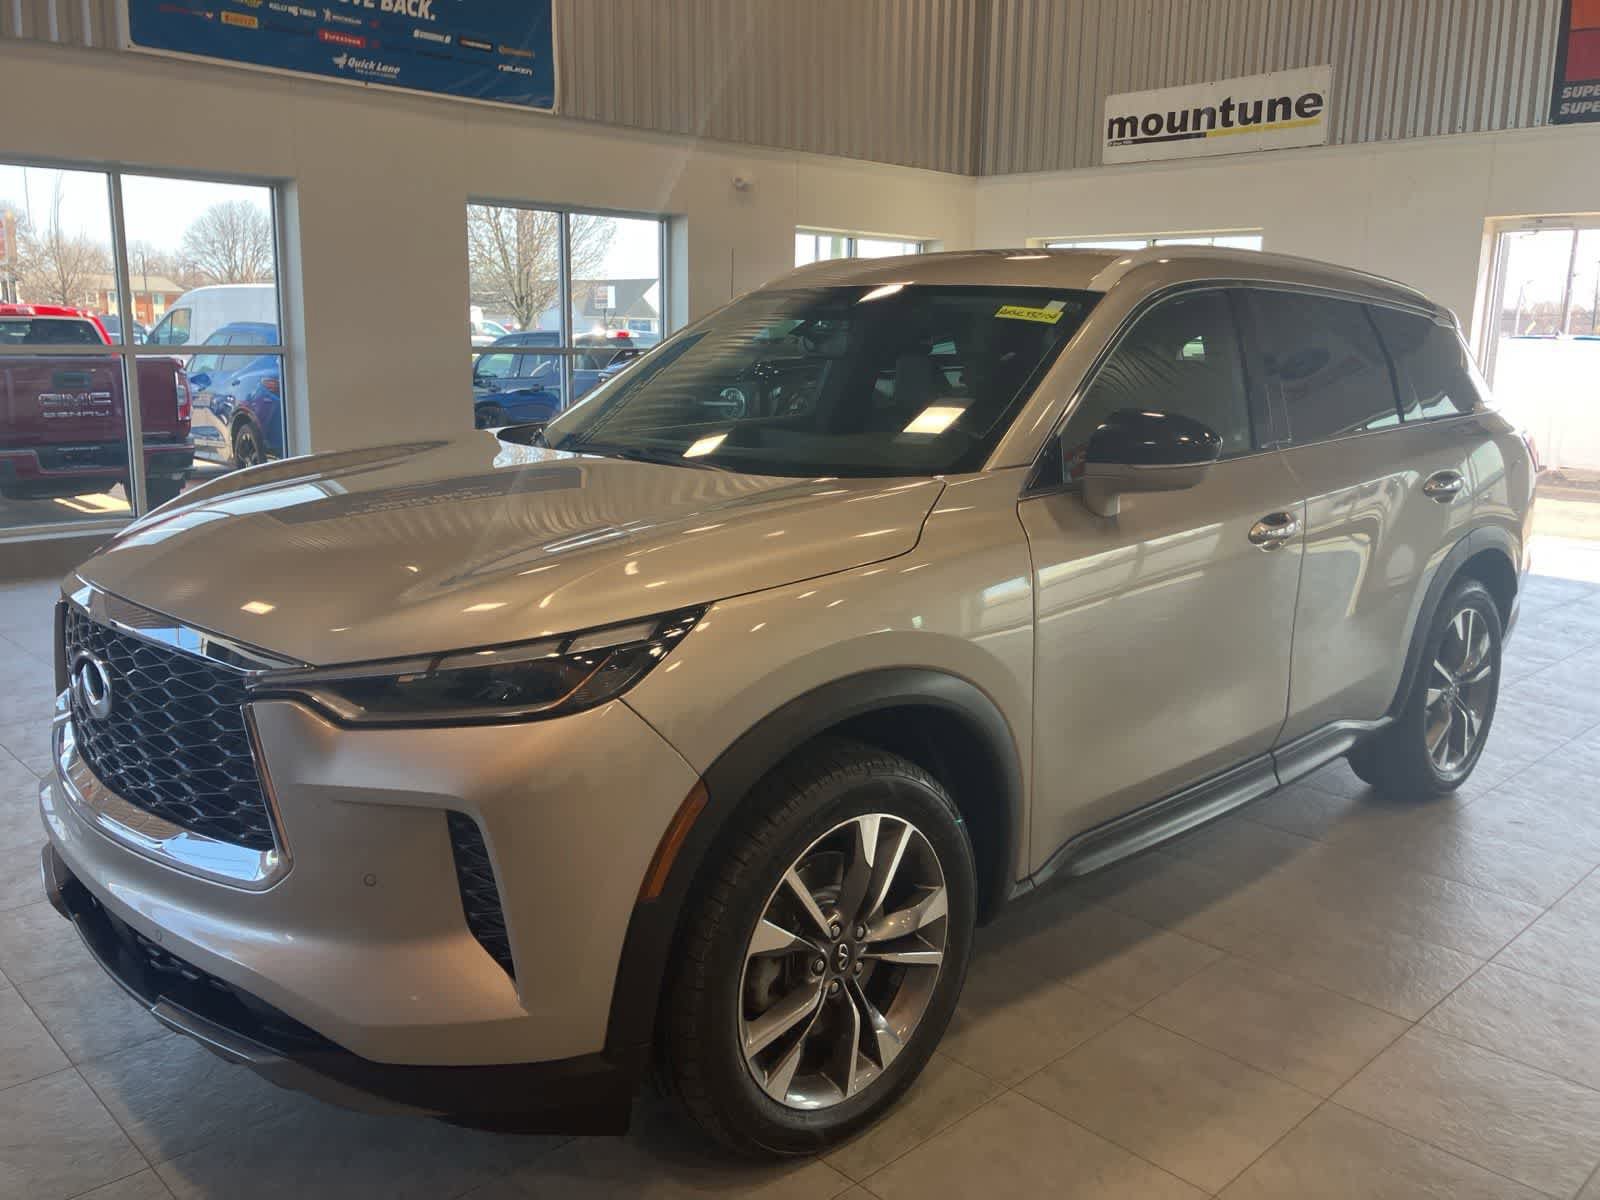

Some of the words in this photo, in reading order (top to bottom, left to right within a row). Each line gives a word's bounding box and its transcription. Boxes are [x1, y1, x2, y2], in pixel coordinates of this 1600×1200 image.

[381, 0, 437, 21] BACK.
[347, 56, 376, 71] Quick
[376, 61, 401, 74] Lane
[1107, 92, 1324, 140] mountune
[38, 391, 111, 406] GMC
